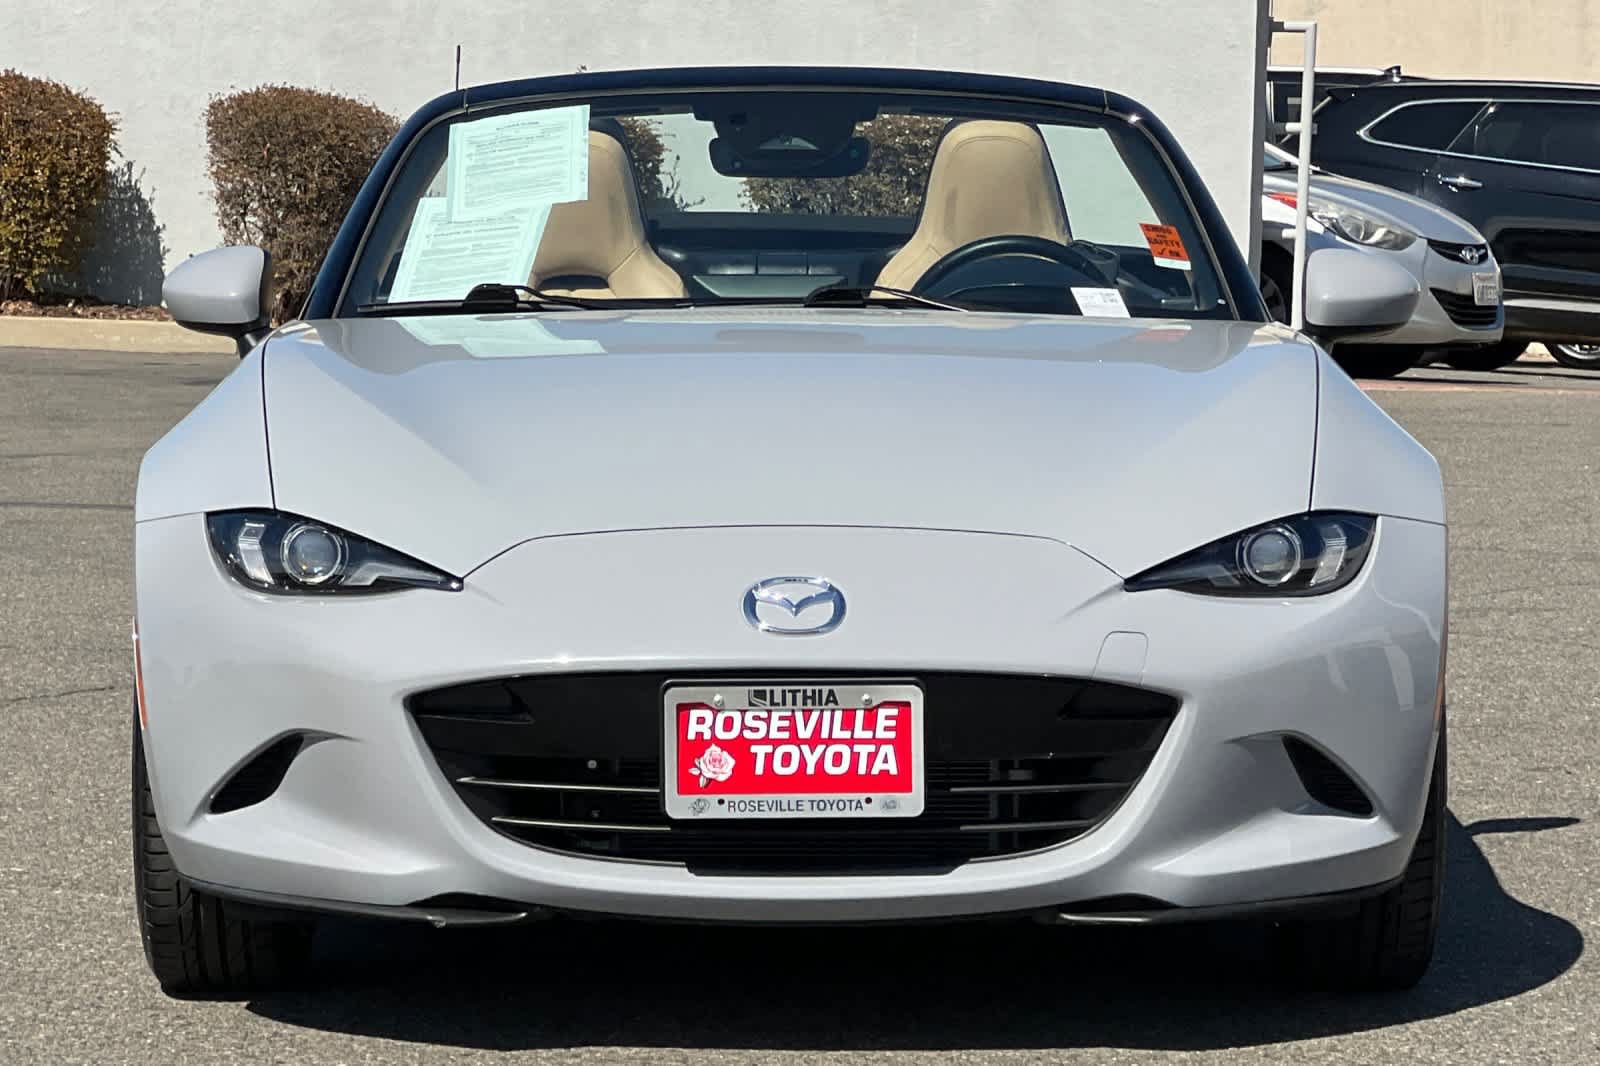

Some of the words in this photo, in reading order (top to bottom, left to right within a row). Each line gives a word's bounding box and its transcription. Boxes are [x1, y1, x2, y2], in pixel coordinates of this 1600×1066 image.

[770, 689, 839, 706] LITHIA
[687, 708, 899, 740] ROSEVILLE
[750, 744, 898, 775] TOYOTA
[728, 799, 805, 813] ROSEVILLE
[808, 798, 864, 812] TOYOTA
